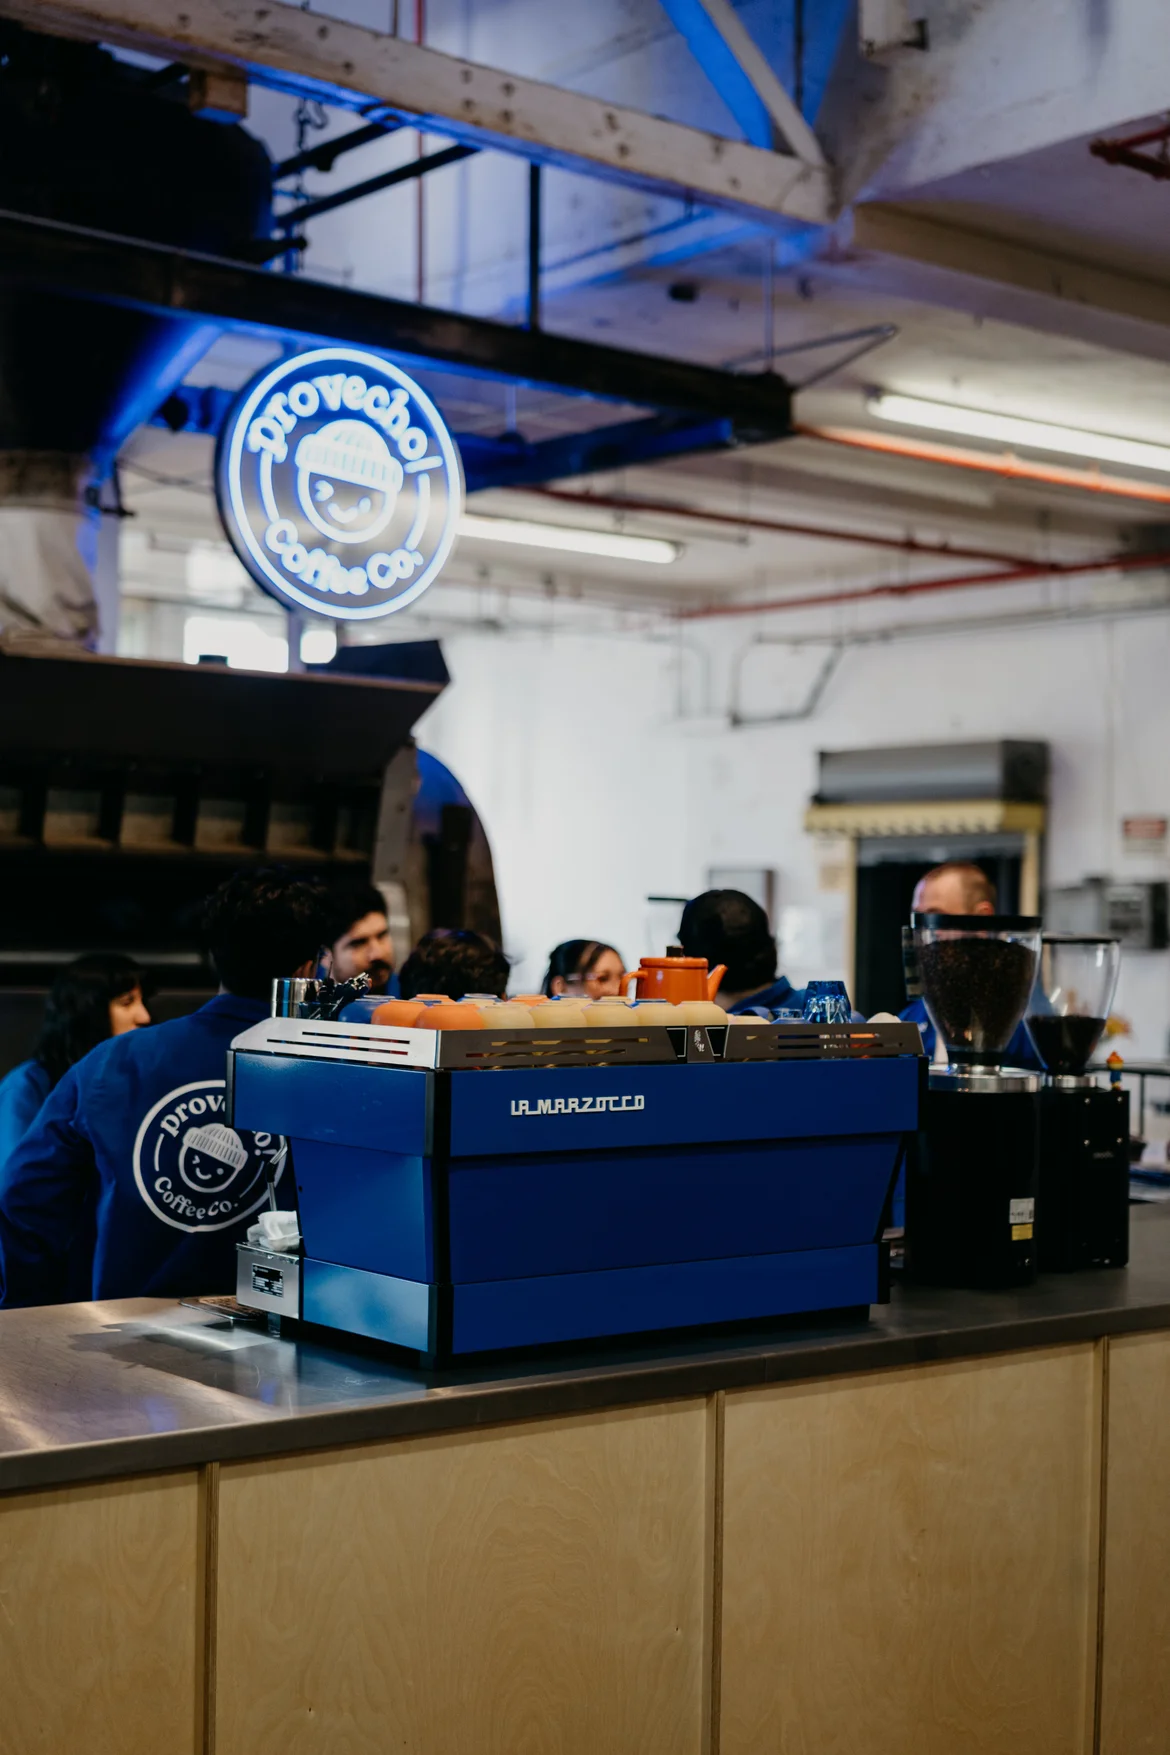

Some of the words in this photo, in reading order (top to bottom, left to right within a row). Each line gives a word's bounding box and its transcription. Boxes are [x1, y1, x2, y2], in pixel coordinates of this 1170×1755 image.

[265, 519, 369, 595] Coffee
[366, 549, 424, 589] Co.
[154, 1176, 206, 1219] Coffee
